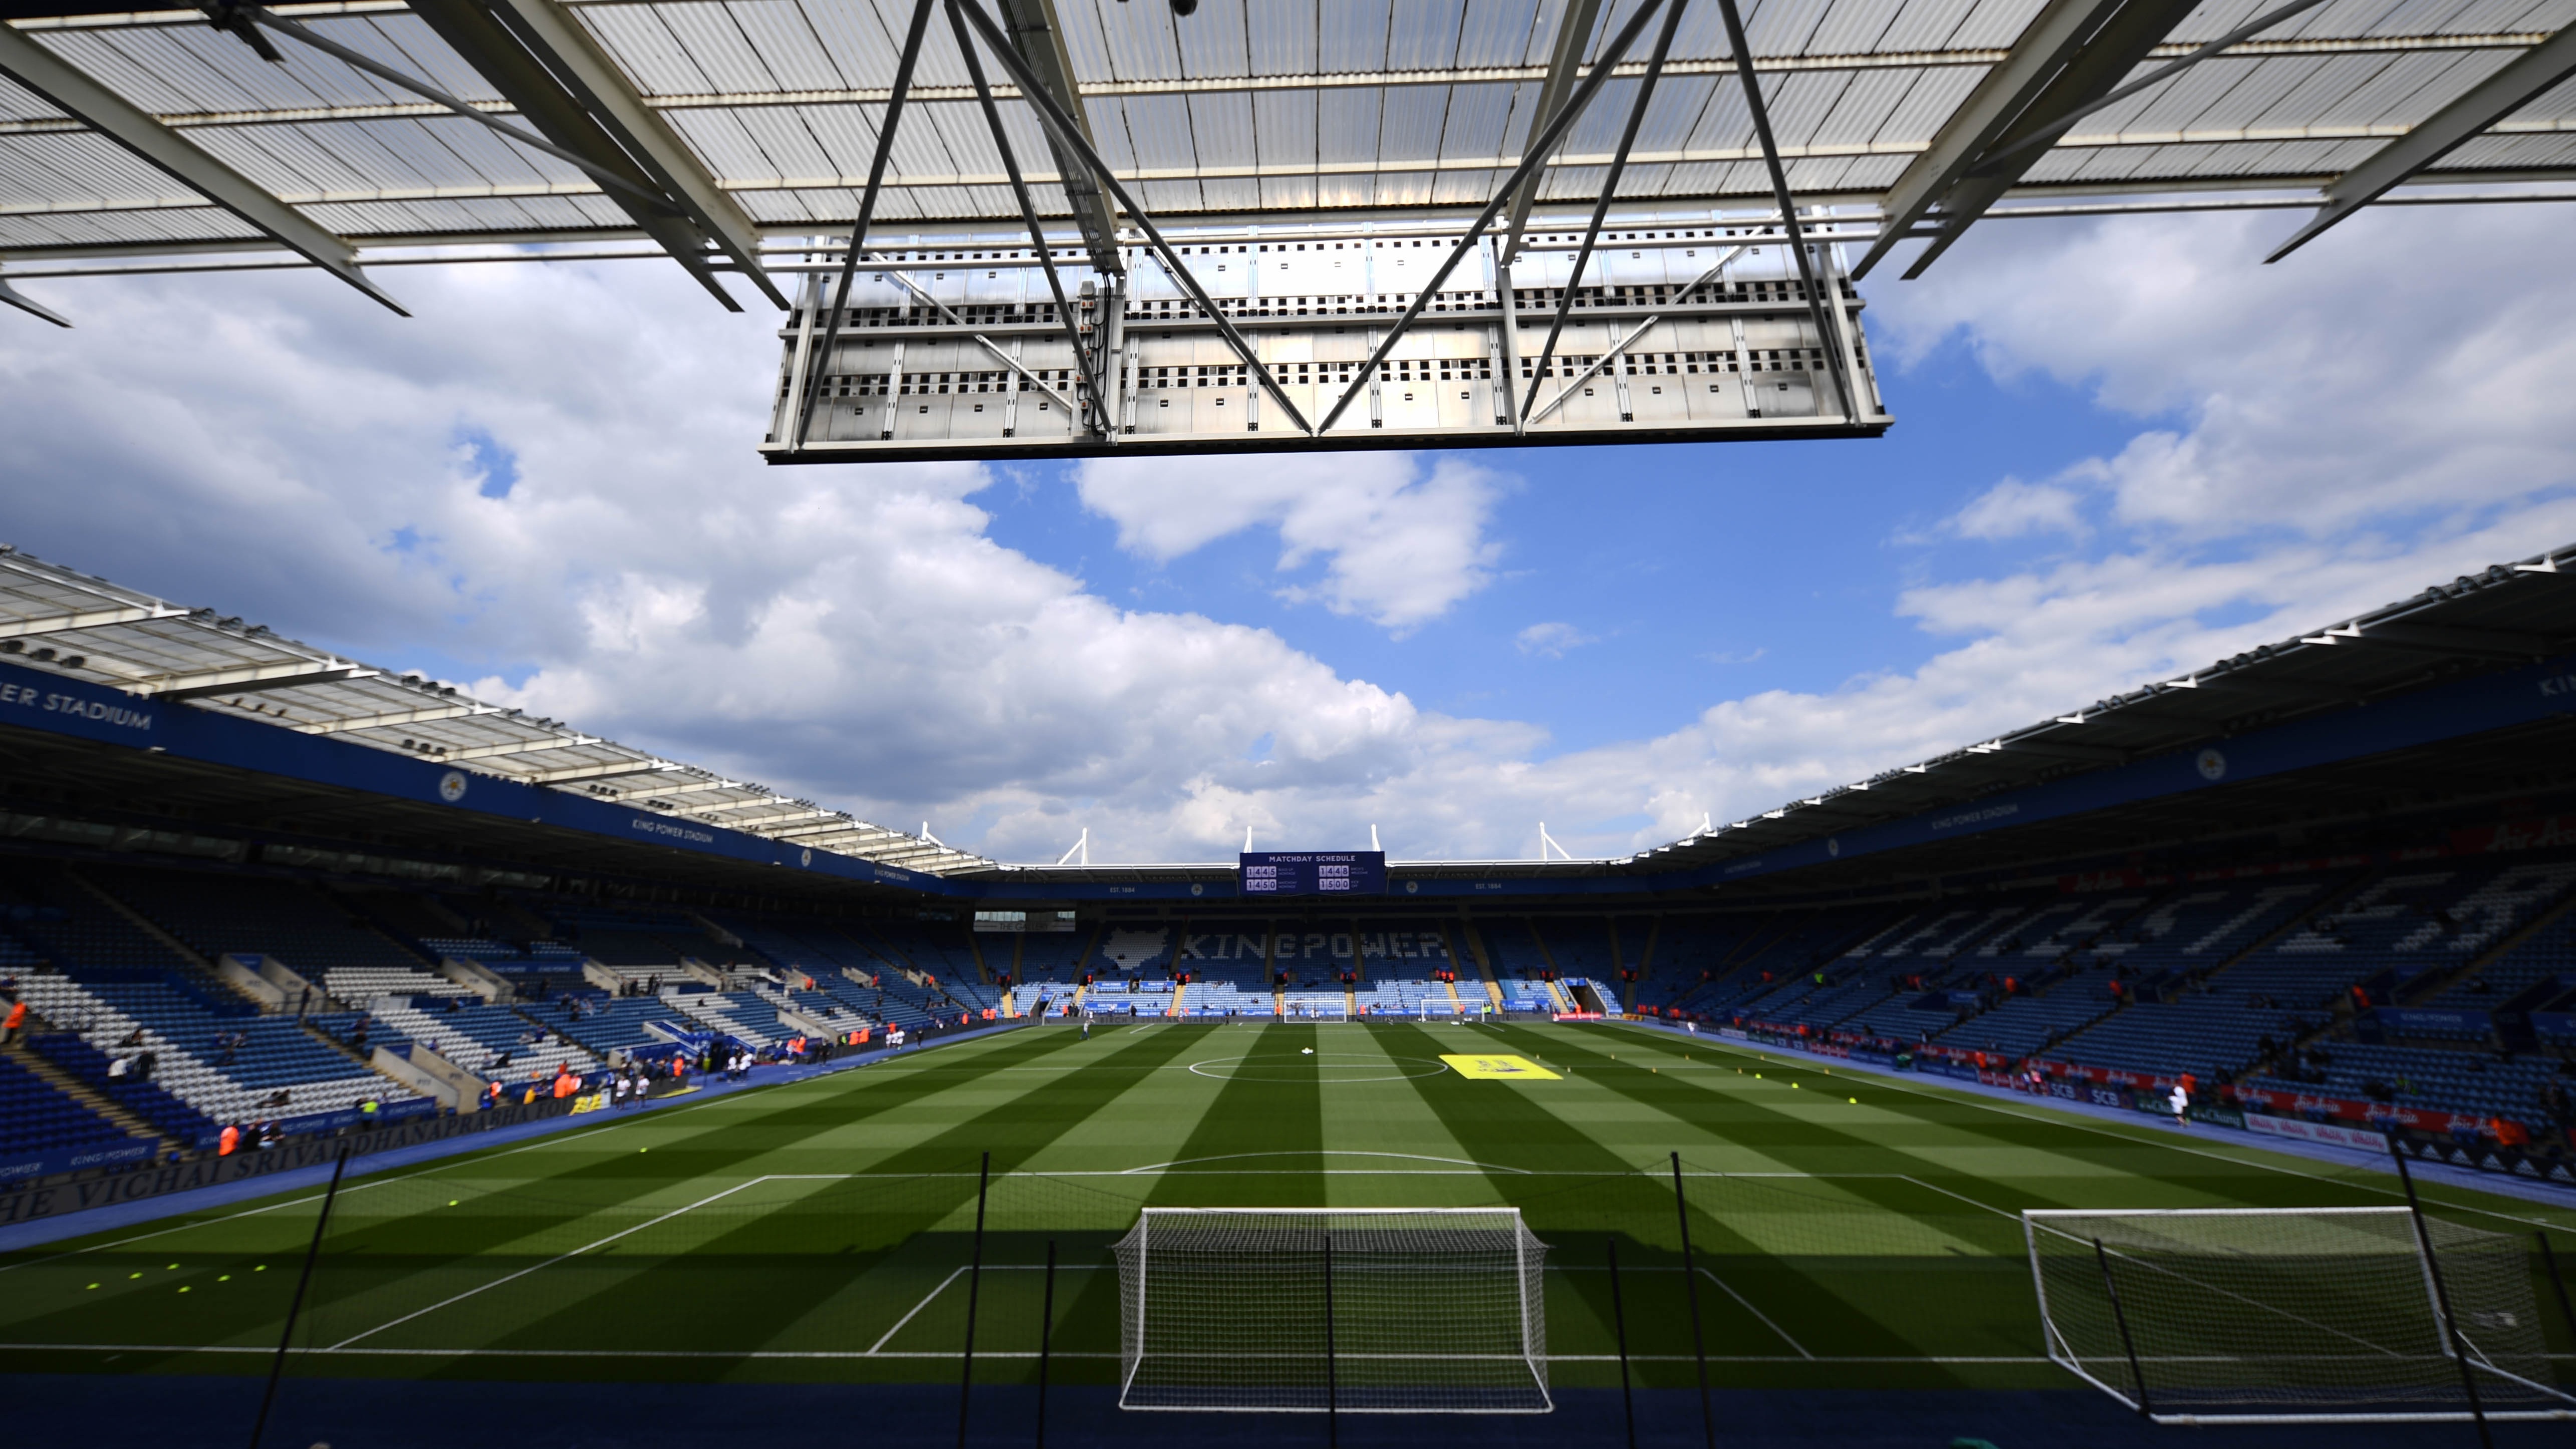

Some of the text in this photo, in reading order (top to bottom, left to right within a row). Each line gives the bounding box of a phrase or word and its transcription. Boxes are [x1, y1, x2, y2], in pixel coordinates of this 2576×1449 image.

[2537, 674, 2576, 698] KI
[0, 682, 152, 731] ER STADIUM
[1931, 802, 2019, 830] KING POWER STADIUM
[632, 819, 713, 844] KING POWER STADIUM
[1248, 867, 1275, 876] 1445
[1320, 867, 1348, 876] 1448
[1248, 881, 1275, 889] 1450
[1320, 880, 1349, 889] 1500
[2050, 1083, 2075, 1099] SCB
[2091, 1089, 2120, 1106] SCB
[70, 1145, 149, 1167] KING POWER
[78, 1153, 226, 1209] VICHAI
